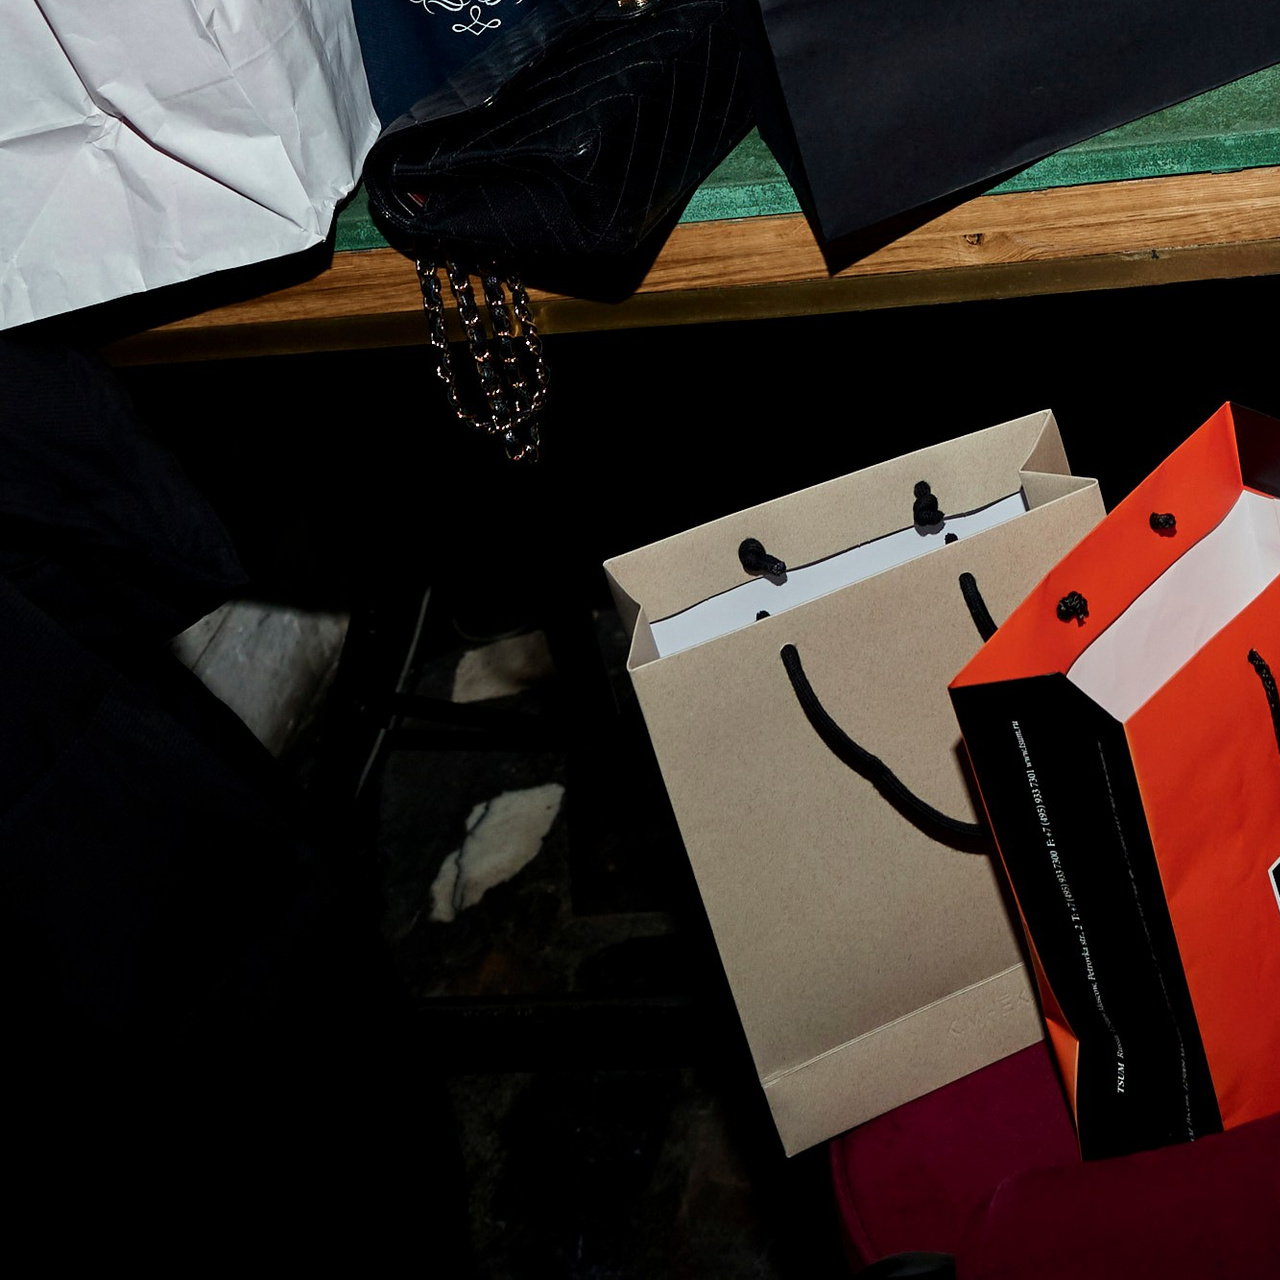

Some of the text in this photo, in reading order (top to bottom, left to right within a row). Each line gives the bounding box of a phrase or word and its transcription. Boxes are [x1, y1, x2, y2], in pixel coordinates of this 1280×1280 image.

[1026, 769, 1039, 788] 7301
[1031, 788, 1044, 804] 933
[1035, 804, 1051, 827] (495)
[1049, 850, 1061, 869] 7300
[1082, 947, 1096, 981] Petrovka
[1116, 1061, 1125, 1093] TSUM
